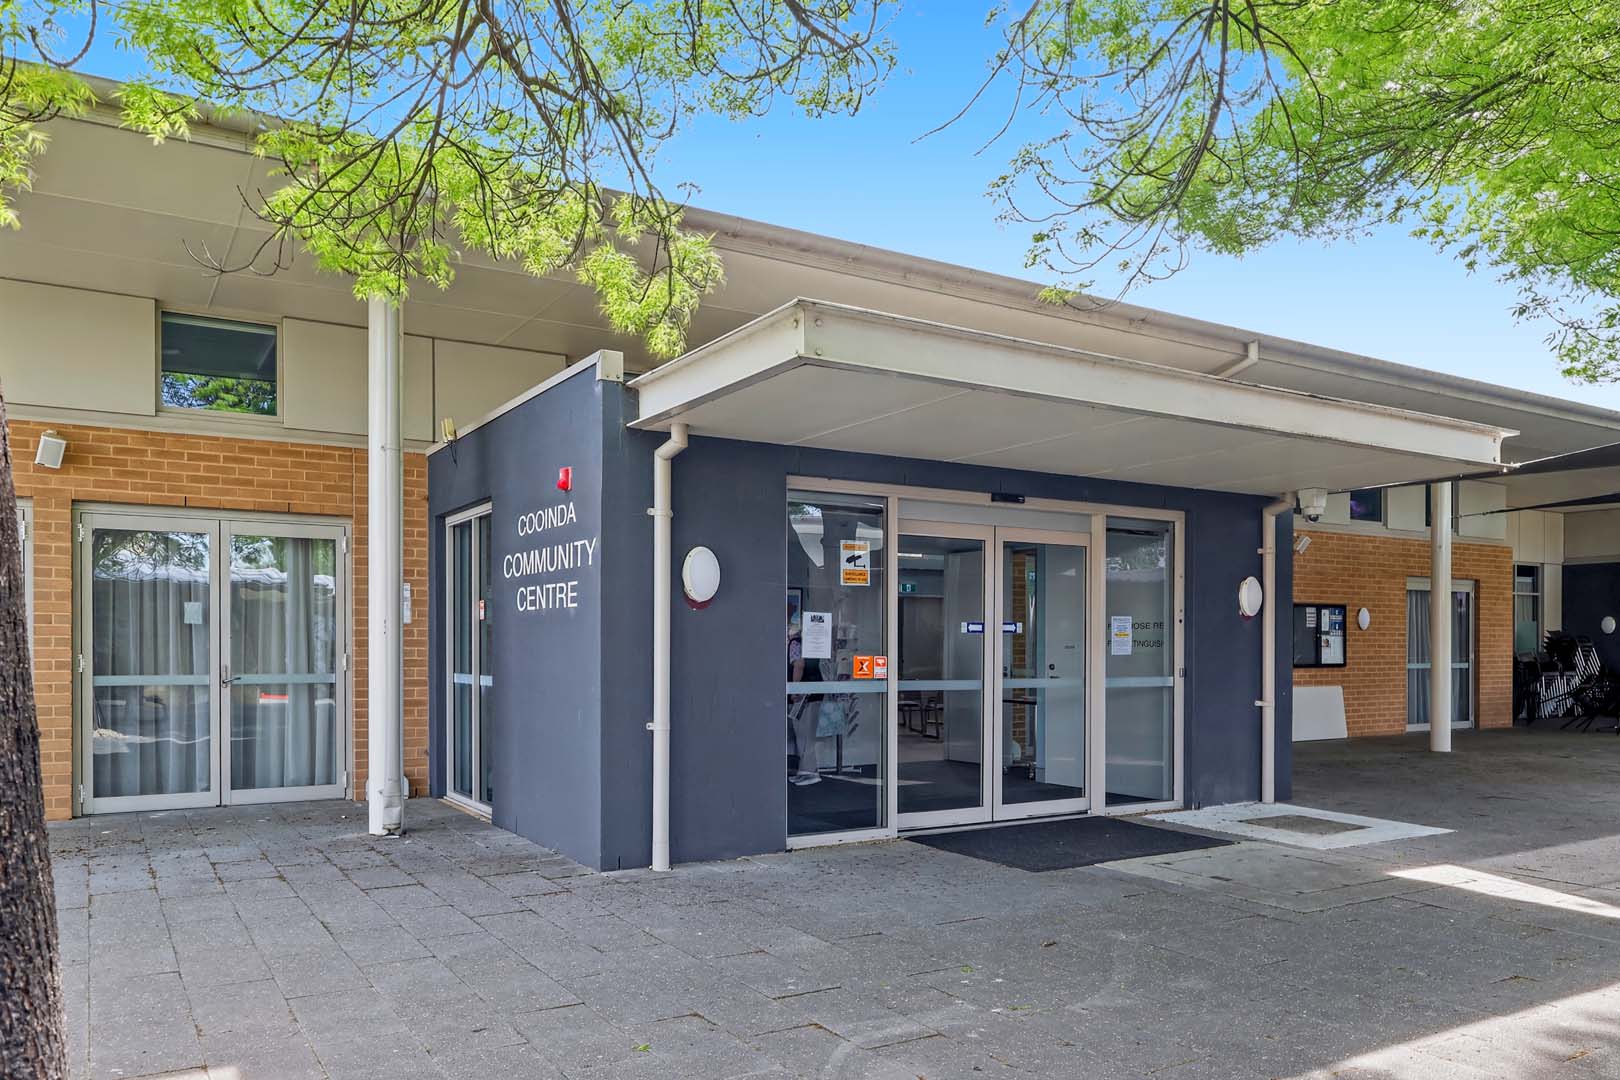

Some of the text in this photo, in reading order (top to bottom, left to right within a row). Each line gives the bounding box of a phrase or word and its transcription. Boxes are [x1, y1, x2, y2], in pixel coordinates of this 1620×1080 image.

[518, 501, 577, 536] COOINDA
[504, 537, 597, 578] COMMUNITY
[517, 582, 578, 612] CENTRE
